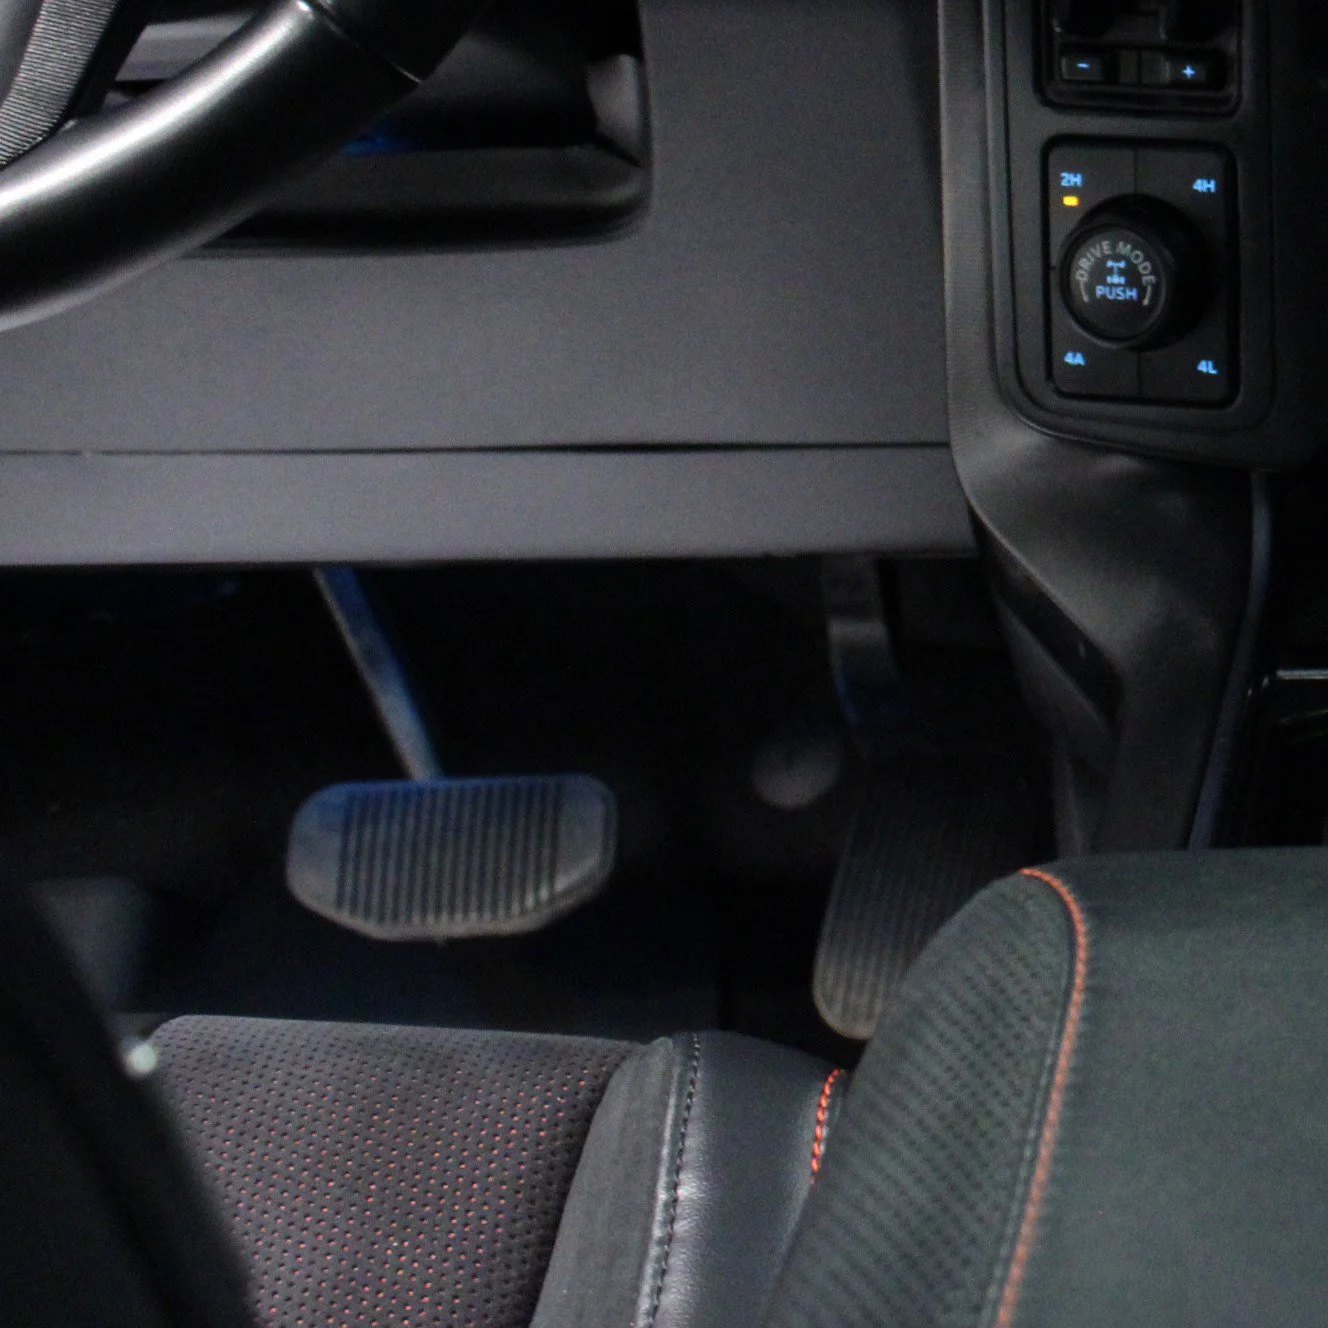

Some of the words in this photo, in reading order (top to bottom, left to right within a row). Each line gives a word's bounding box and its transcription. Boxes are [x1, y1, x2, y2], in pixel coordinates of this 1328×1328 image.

[1060, 172, 1082, 187] 2H
[1192, 178, 1216, 193] 4H
[1075, 240, 1112, 282] DRIVE
[1117, 240, 1157, 286] MODE
[1095, 285, 1139, 301] PUSH
[1063, 351, 1086, 366] 4A
[1197, 359, 1218, 375] 4L
